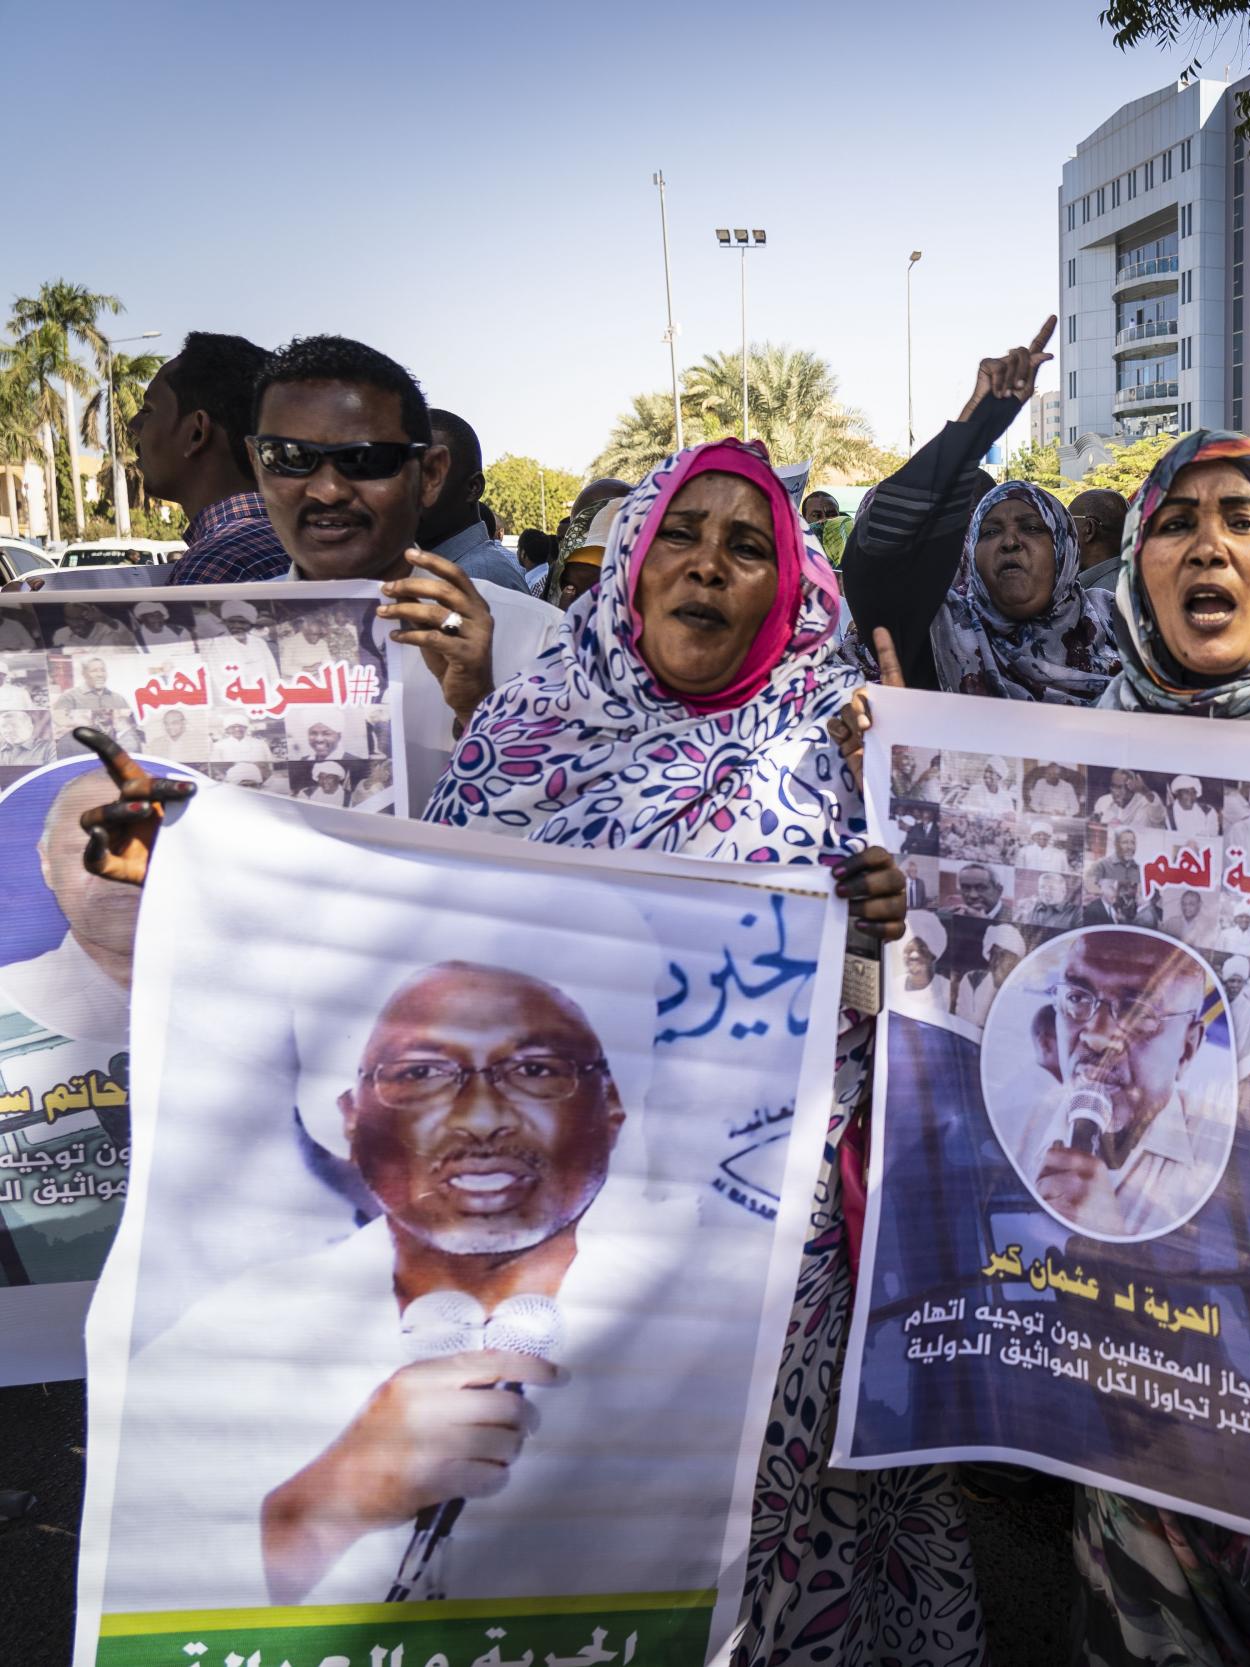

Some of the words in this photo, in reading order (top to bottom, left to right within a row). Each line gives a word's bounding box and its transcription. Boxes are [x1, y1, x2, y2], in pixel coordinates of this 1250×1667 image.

[134, 664, 208, 721] لهم
[225, 664, 377, 716] #الحرية
[1143, 848, 1211, 898] لهم
[43, 1074, 129, 1122] حاتم
[0, 1143, 85, 1174] توجيه
[982, 1246, 1022, 1278] كبر
[1030, 1255, 1099, 1300] عثمان
[904, 1297, 966, 1332] اتهام
[975, 1304, 1045, 1335] توجيه
[1144, 1286, 1220, 1337] الحرية
[907, 1333, 992, 1365] الدولية
[1051, 1320, 1092, 1350] دون
[1000, 1337, 1089, 1381] المواثيق
[1099, 1336, 1211, 1386] المعتقلين
[1097, 1367, 1137, 1397] لكل
[1144, 1379, 1210, 1421] تجاوزا
